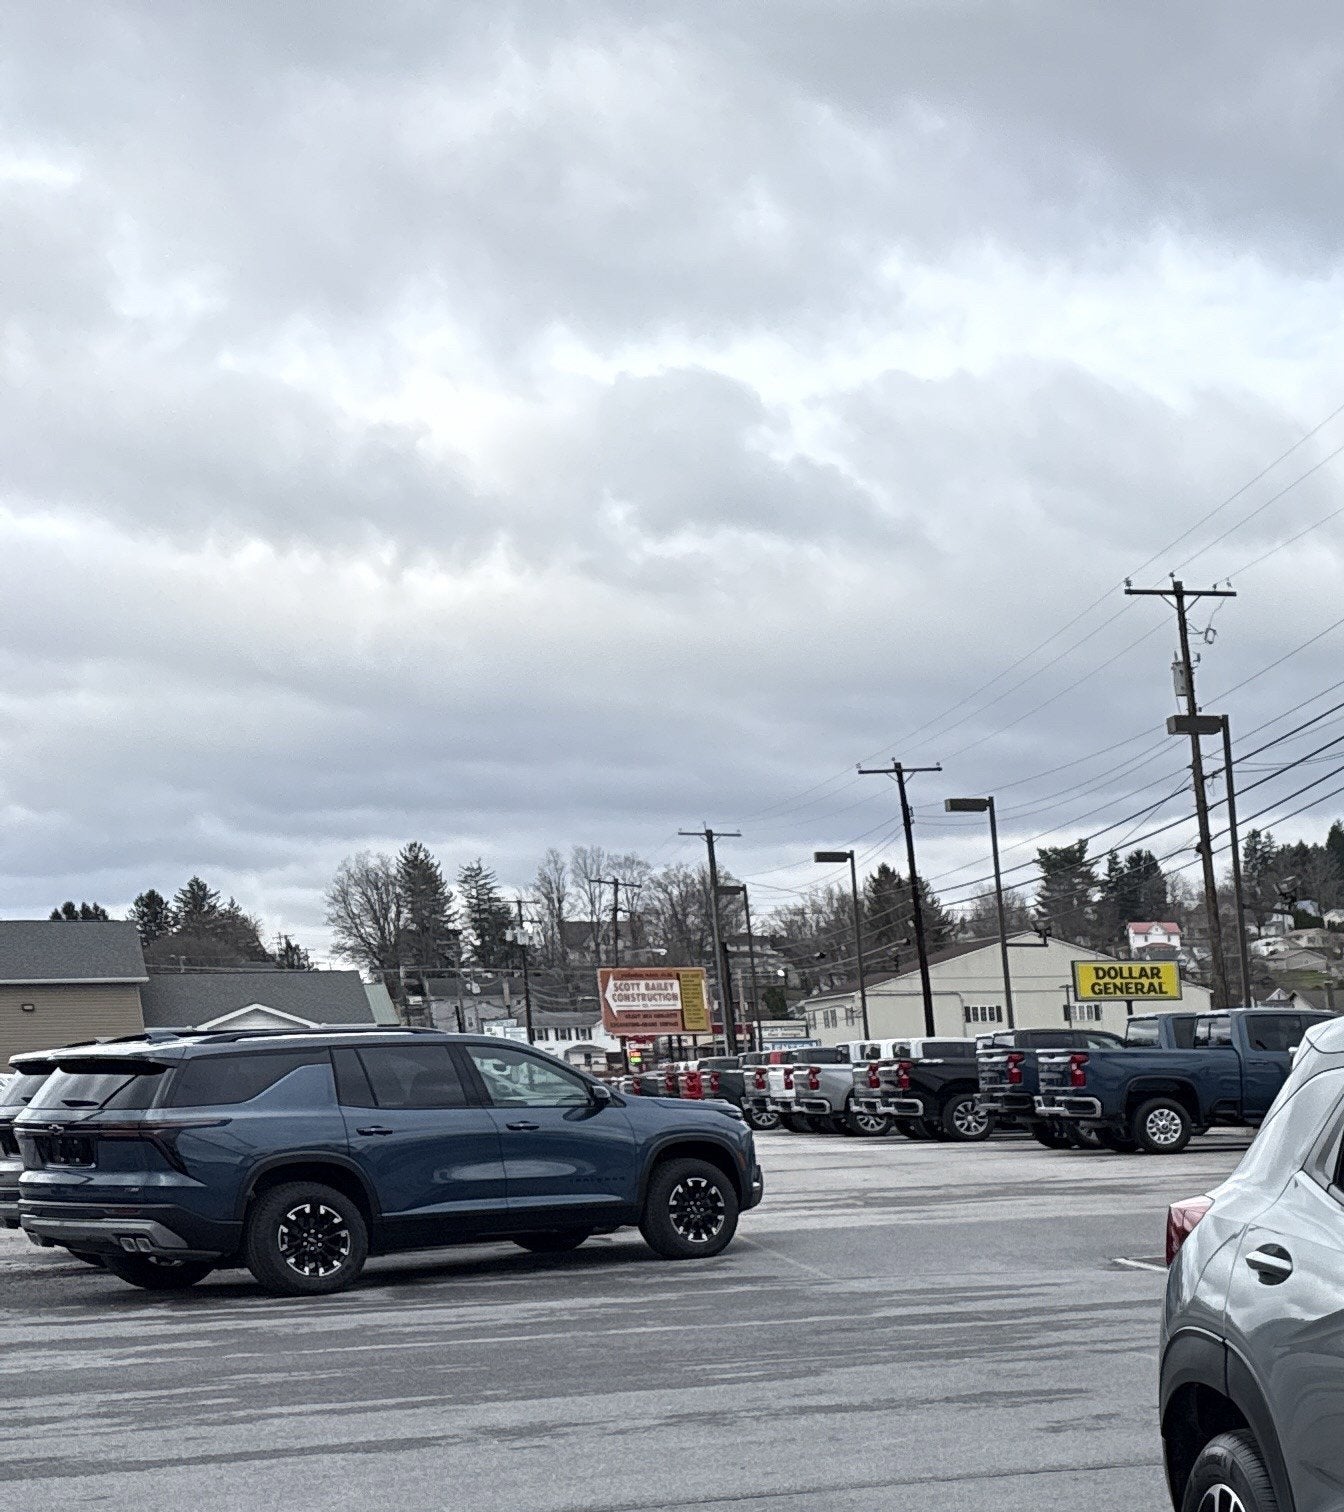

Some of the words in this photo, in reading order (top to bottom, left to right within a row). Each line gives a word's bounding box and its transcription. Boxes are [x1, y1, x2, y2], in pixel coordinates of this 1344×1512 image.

[1093, 966, 1162, 980] DOLLAR
[613, 982, 641, 992] SCOTT
[645, 981, 674, 992] BAILEY
[1090, 981, 1168, 995] GENERAL
[612, 993, 679, 1002] CONSTRUCTION
